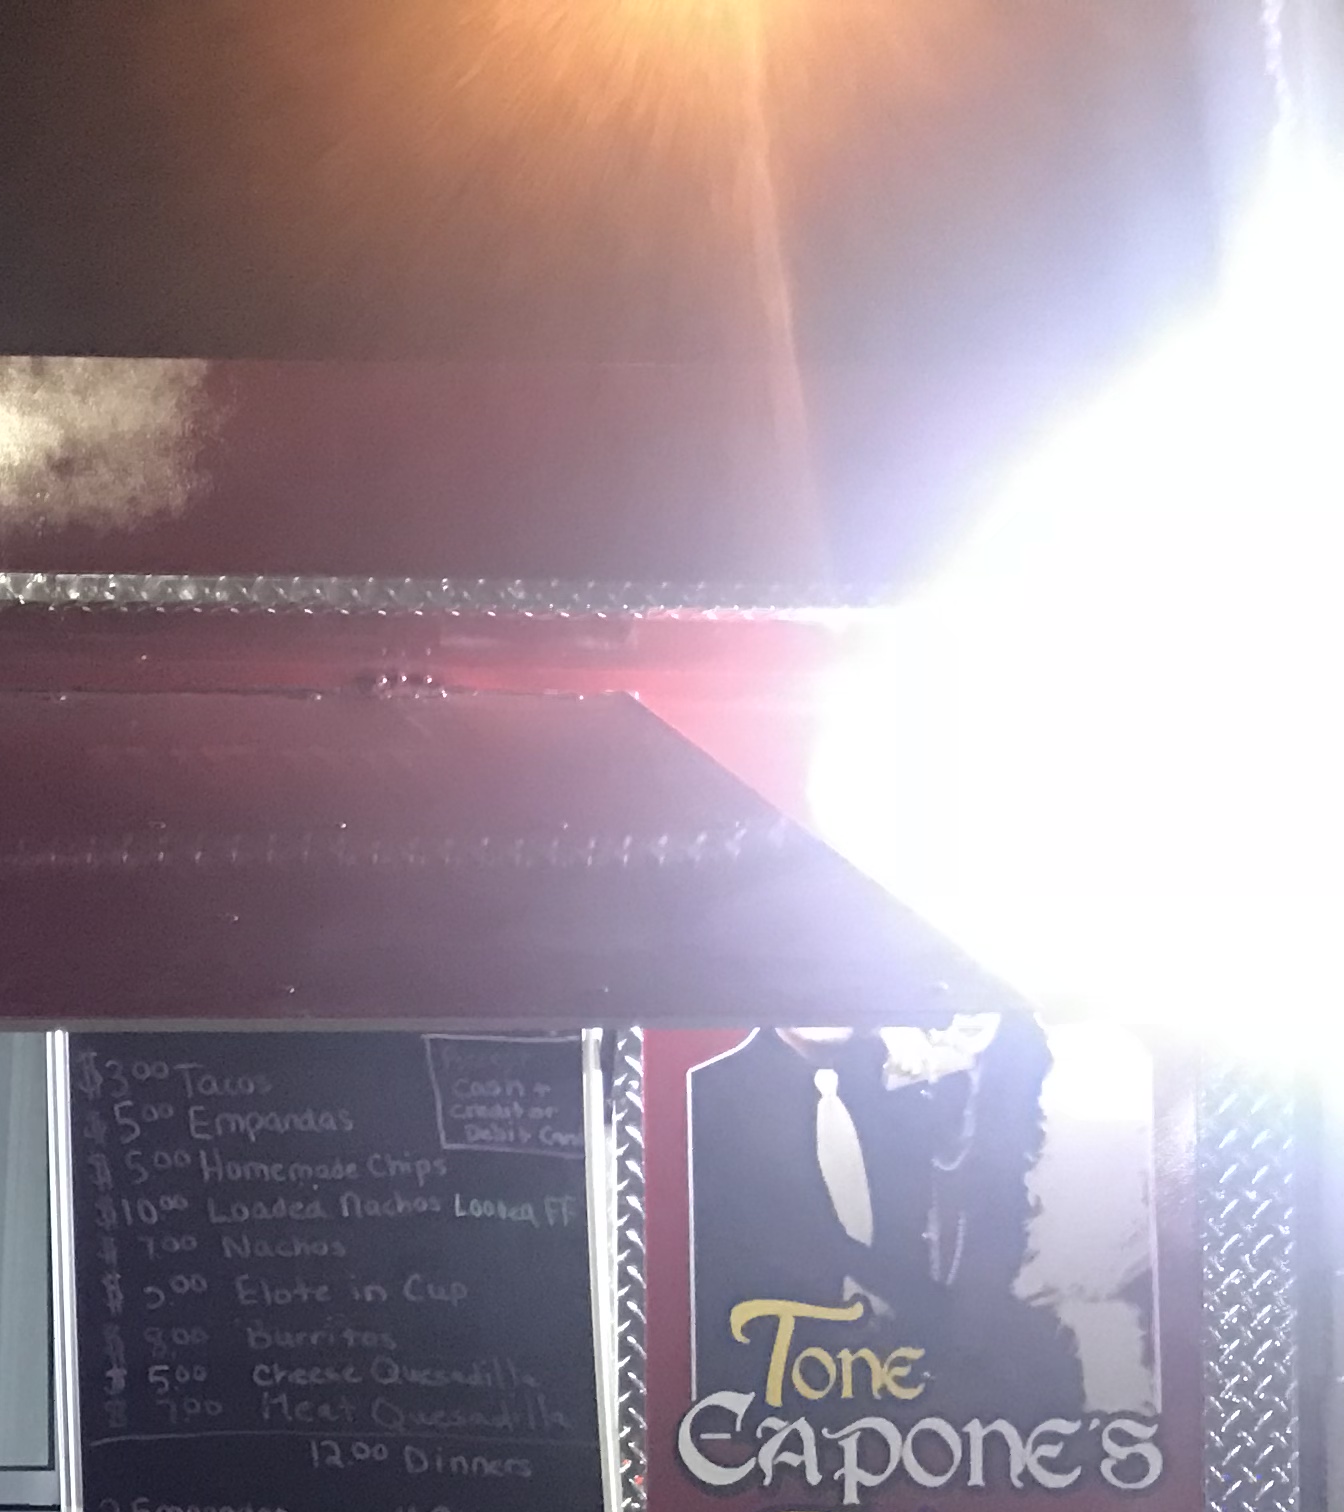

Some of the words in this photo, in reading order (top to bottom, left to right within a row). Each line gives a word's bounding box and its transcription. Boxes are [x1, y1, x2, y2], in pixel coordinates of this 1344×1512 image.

[173, 1061, 273, 1098] Tacos
[188, 1104, 355, 1144] Empandas
[200, 1147, 360, 1185] Homemade
[367, 1151, 448, 1188] Chips
[207, 1197, 328, 1225] Loaded
[222, 1234, 347, 1259] Nachos
[235, 1272, 332, 1307] Elote
[350, 1273, 390, 1304] in
[402, 1274, 470, 1307] Cup
[370, 1354, 542, 1390] Quesadilla
[261, 1391, 356, 1423] Meat
[370, 1392, 573, 1433] Quesadilla
[403, 1444, 534, 1478] Dinners
